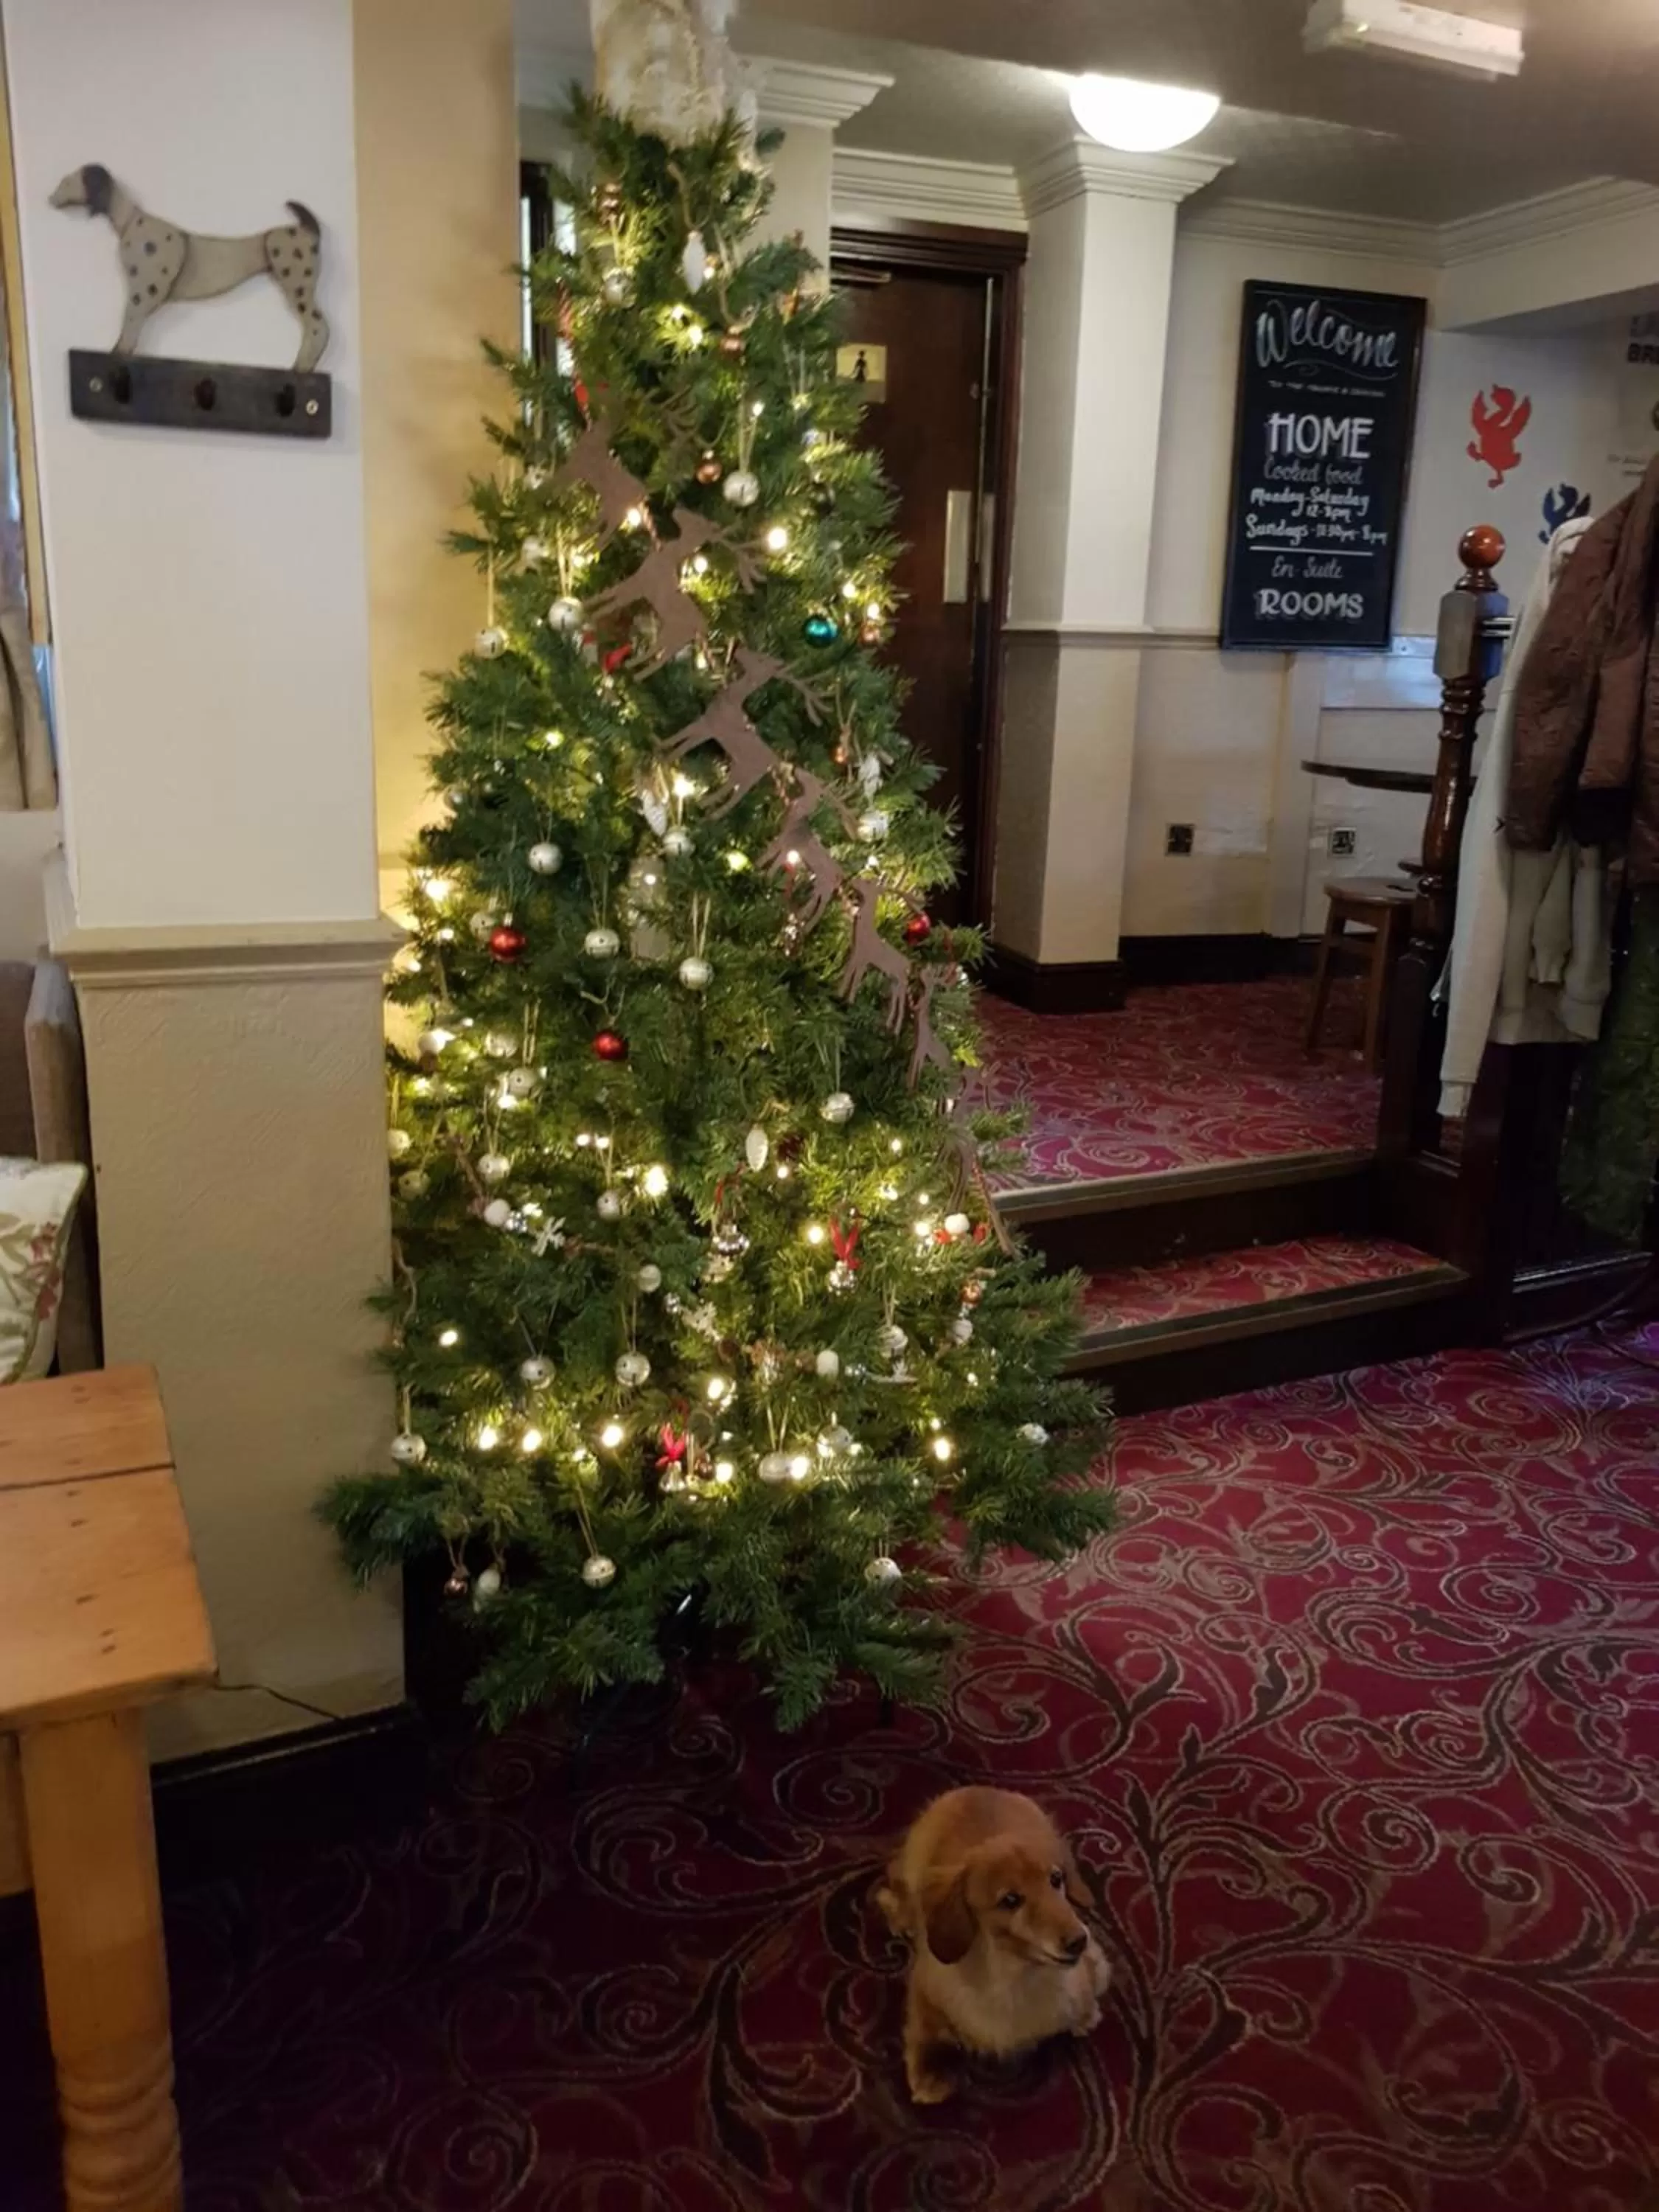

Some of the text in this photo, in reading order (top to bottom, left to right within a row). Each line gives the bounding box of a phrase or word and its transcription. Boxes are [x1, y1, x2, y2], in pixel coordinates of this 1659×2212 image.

[1256, 299, 1399, 368] Welcome
[1267, 411, 1375, 459] HOME
[1259, 588, 1364, 619] ROOMS
